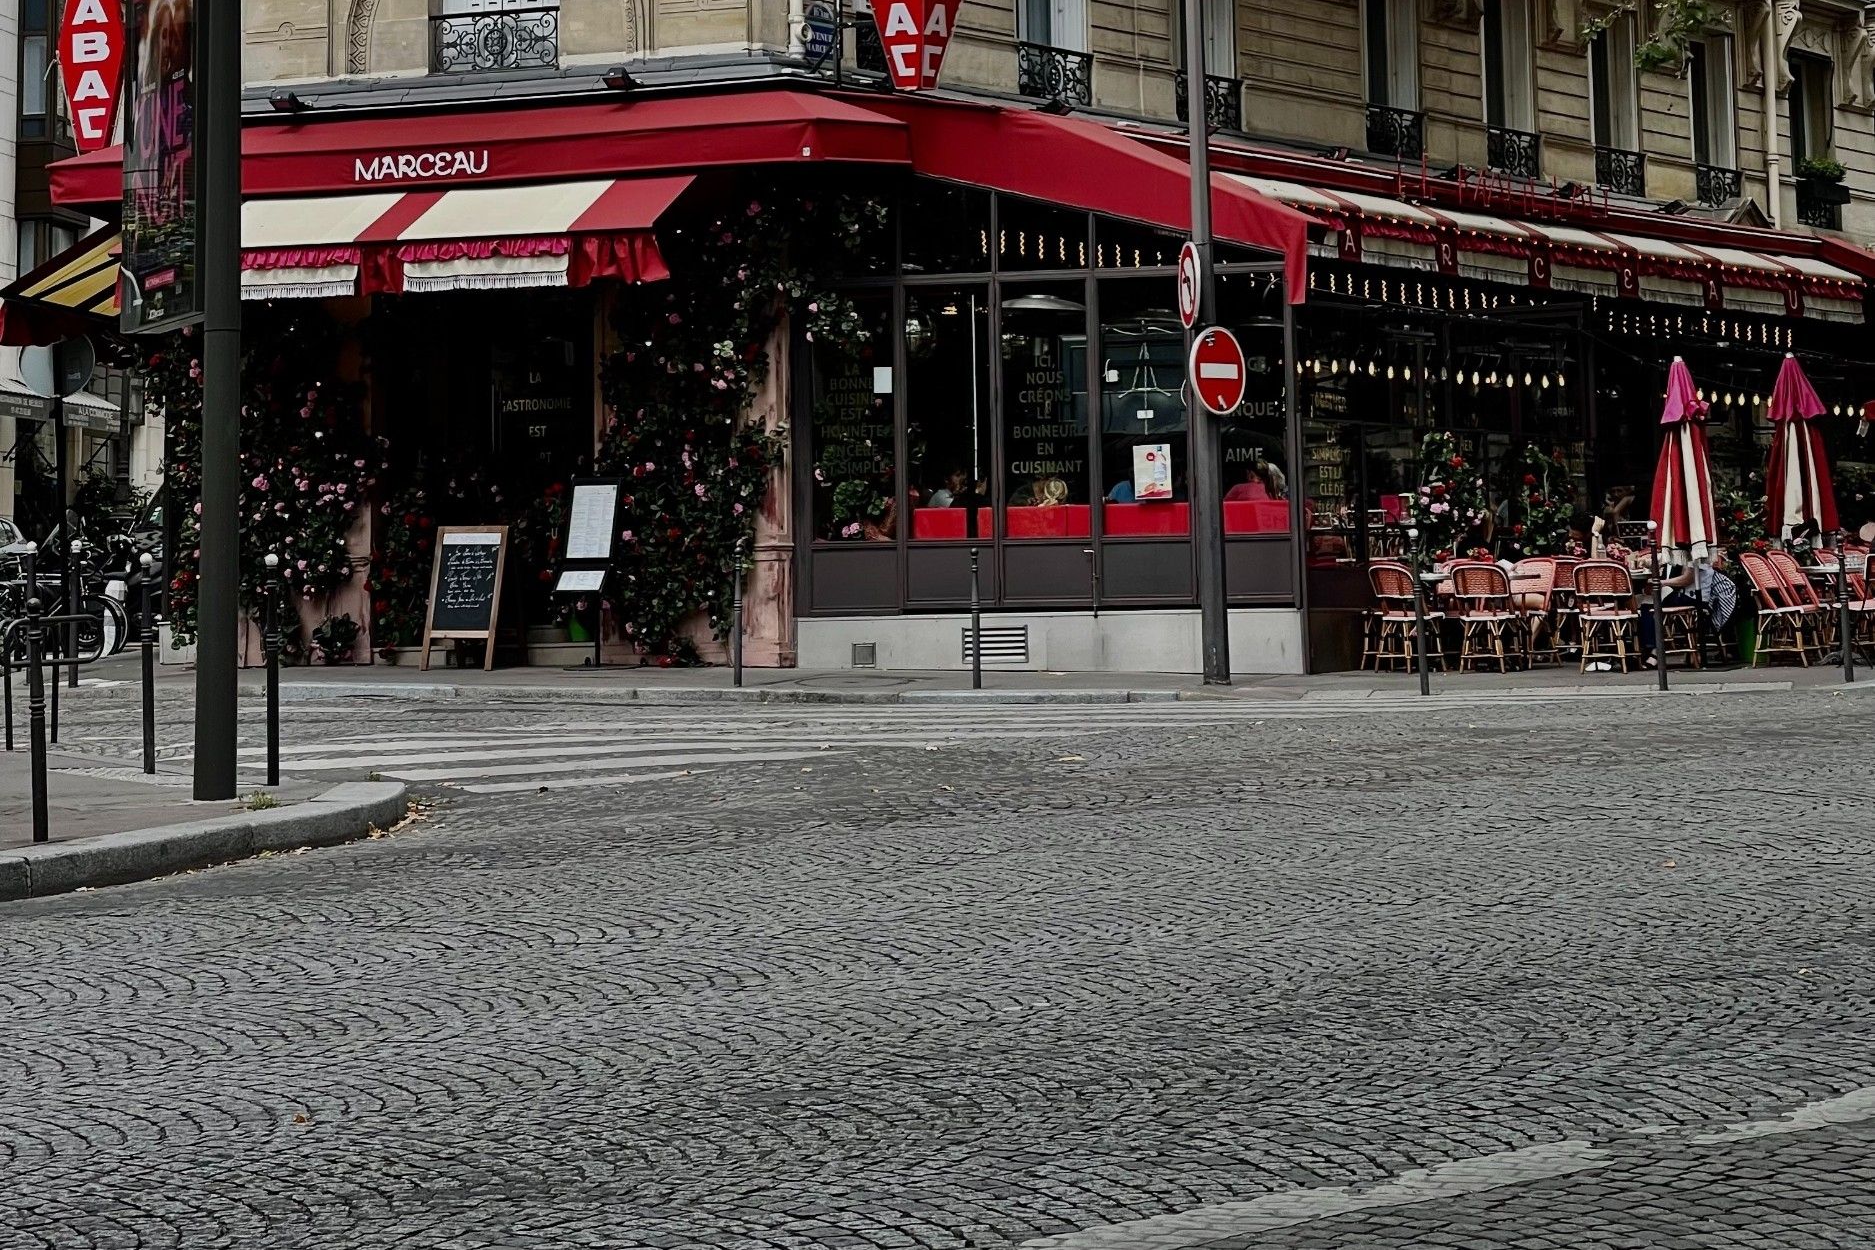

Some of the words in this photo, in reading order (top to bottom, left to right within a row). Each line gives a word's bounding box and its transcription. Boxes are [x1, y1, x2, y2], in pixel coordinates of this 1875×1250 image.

[355, 150, 488, 181] MARCEAU
[528, 372, 542, 384] LA
[1026, 371, 1065, 384] NOUS
[1018, 387, 1072, 404] CRÉONS
[841, 408, 864, 421] EST
[528, 425, 547, 438] EST
[1326, 430, 1337, 443] LA
[1037, 442, 1054, 455] EN
[1225, 447, 1262, 462] AIME
[1011, 460, 1083, 474] CUISINANT
